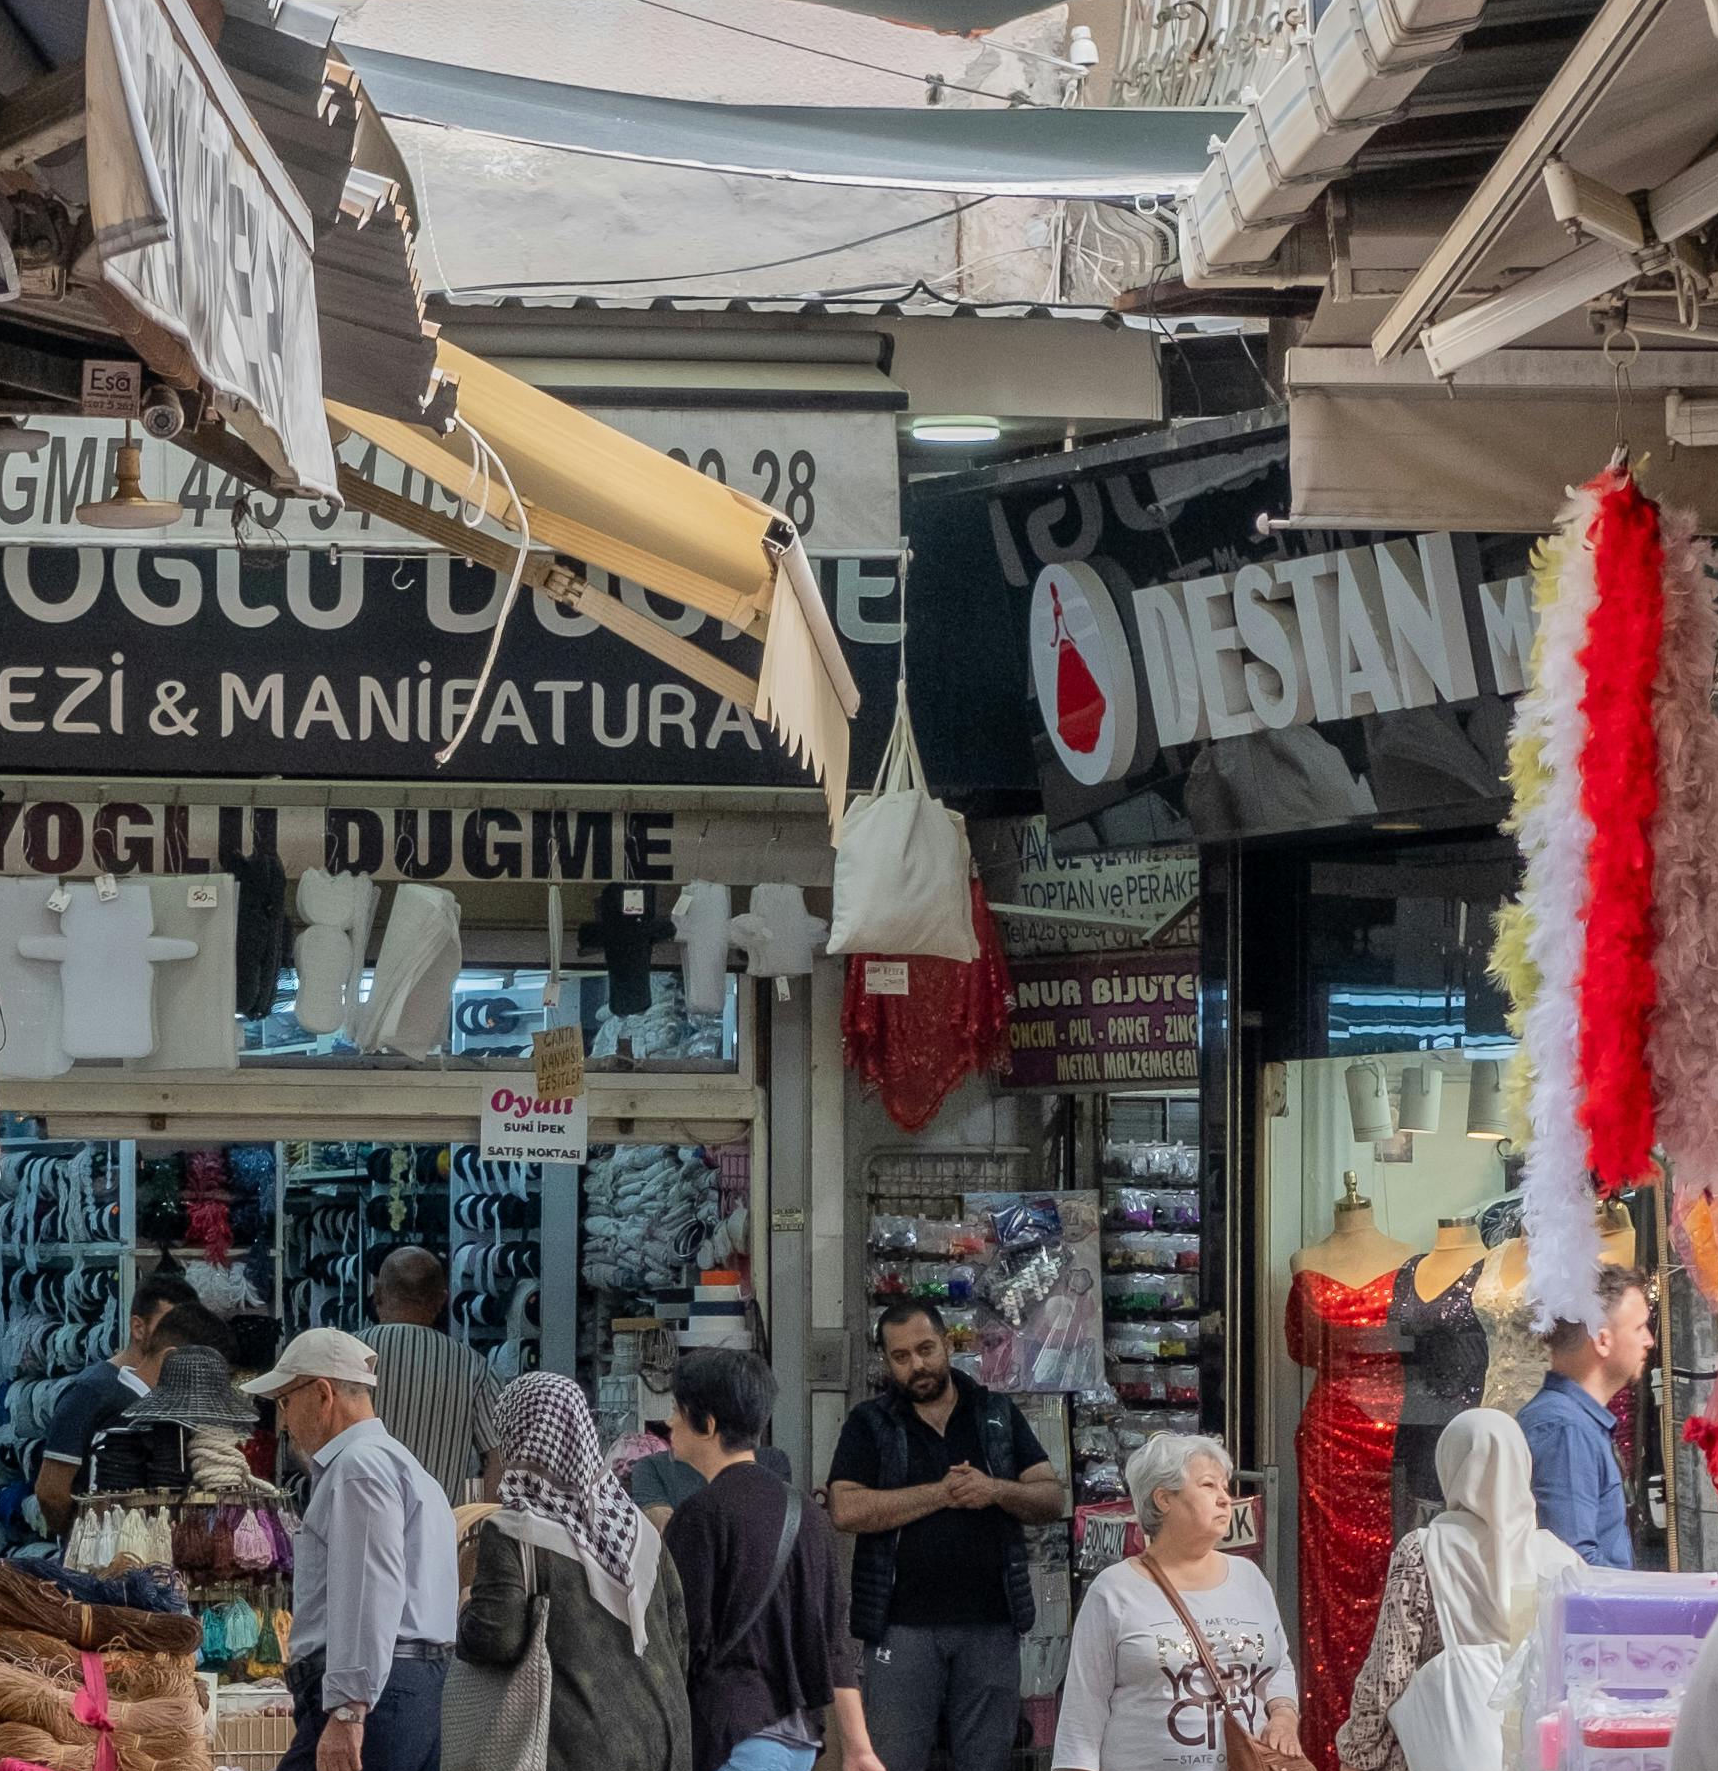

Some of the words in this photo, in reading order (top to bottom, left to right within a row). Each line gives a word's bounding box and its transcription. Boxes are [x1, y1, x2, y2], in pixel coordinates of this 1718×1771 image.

[1132, 532, 1477, 747] DESTAN
[149, 678, 200, 738] &
[1018, 979, 1082, 1009] NUR
[1069, 1018, 1095, 1047] PUL
[1057, 1054, 1101, 1081] METAL
